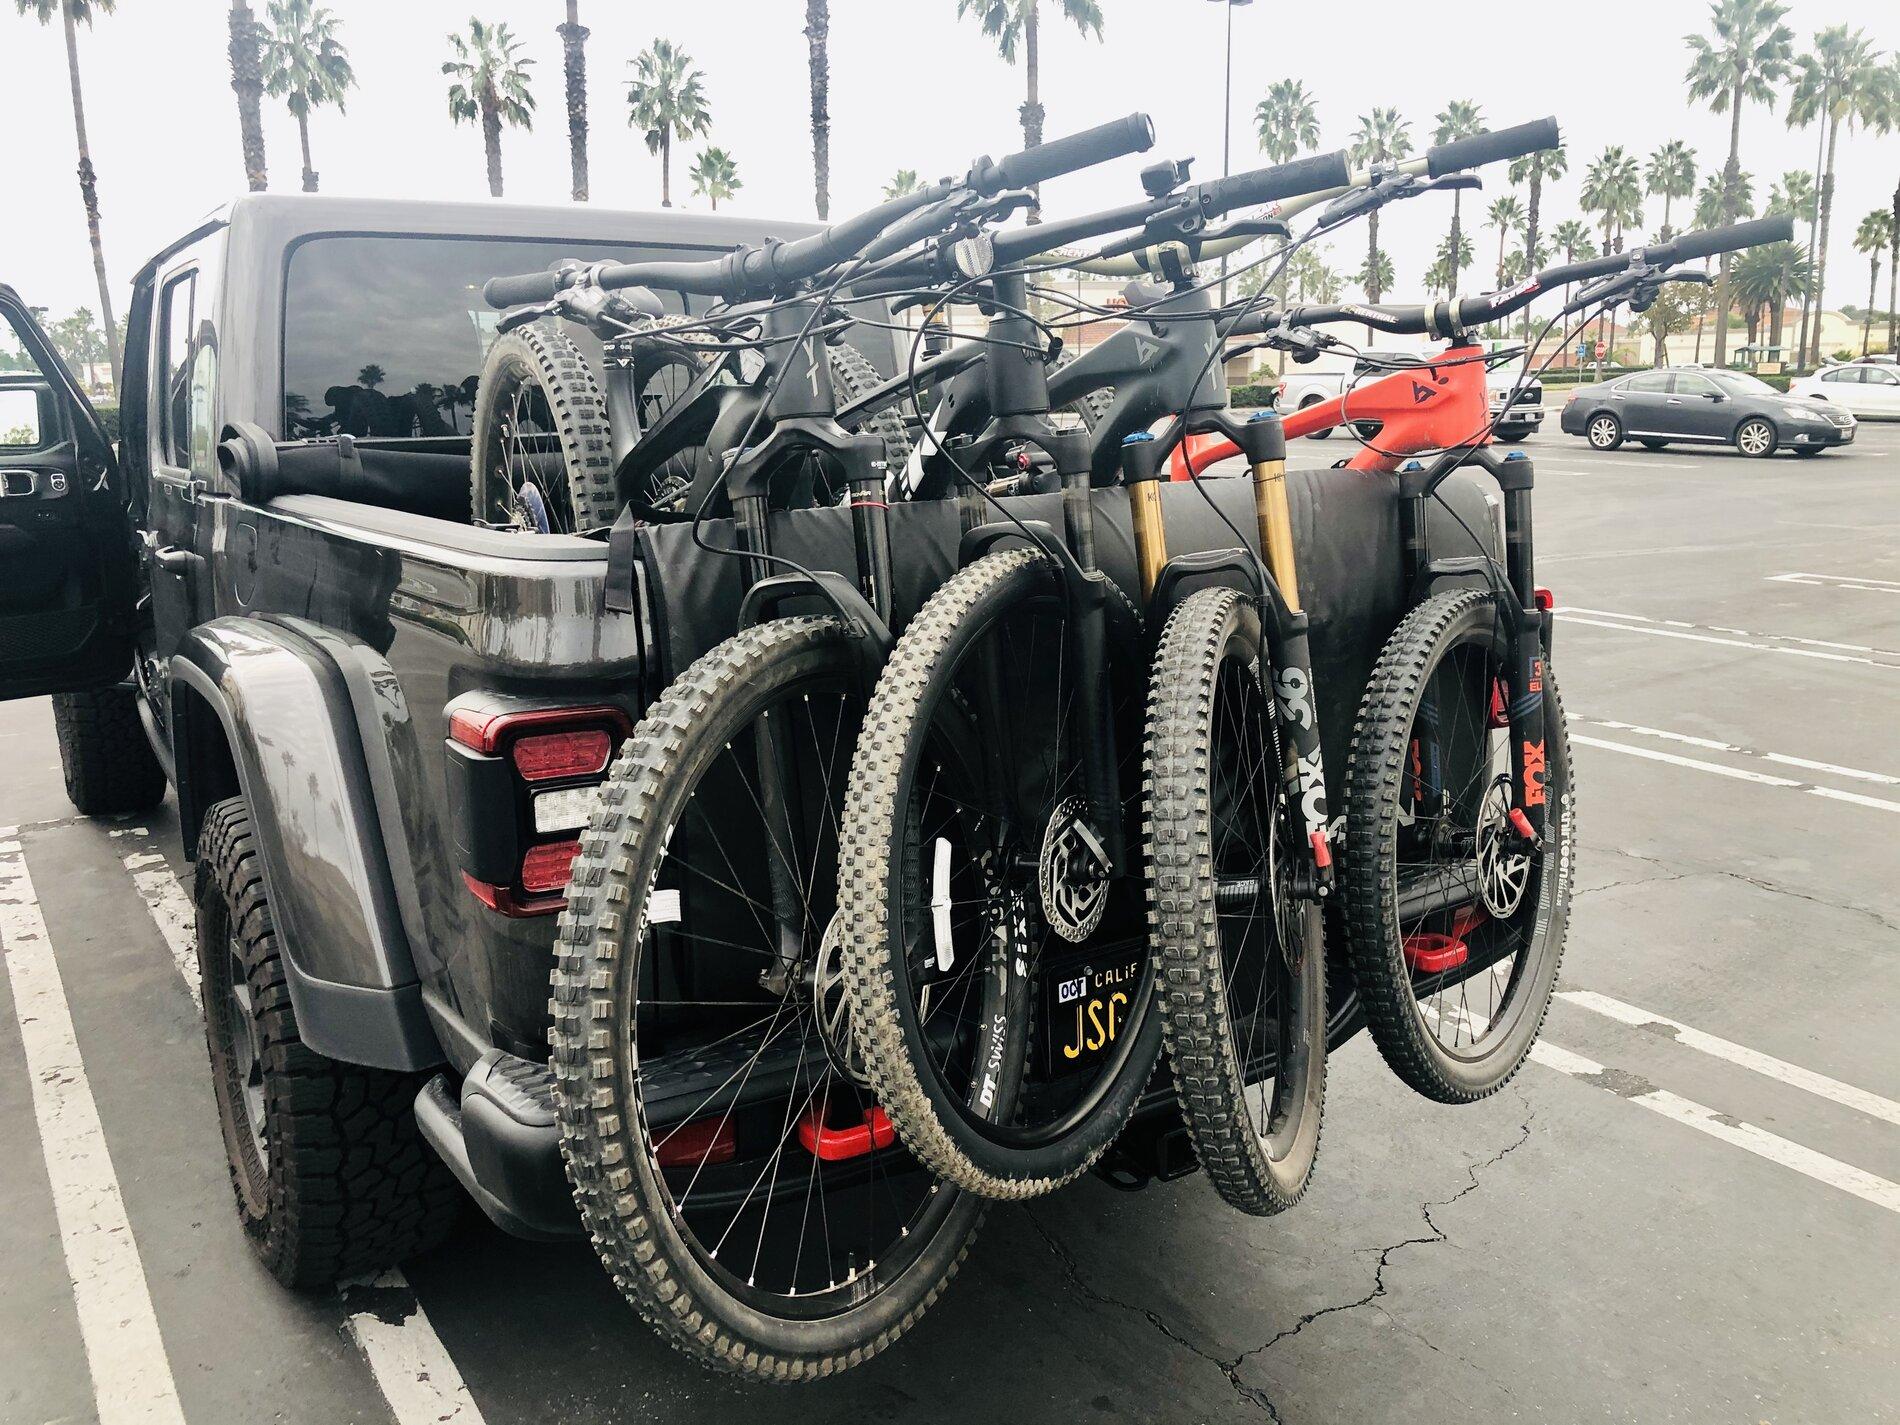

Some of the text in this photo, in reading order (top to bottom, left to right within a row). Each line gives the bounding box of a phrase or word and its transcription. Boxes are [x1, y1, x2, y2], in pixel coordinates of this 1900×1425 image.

[1523, 741, 1546, 807] FOX
[988, 1014, 1007, 1073] SWISS
[980, 1072, 997, 1109] DT
